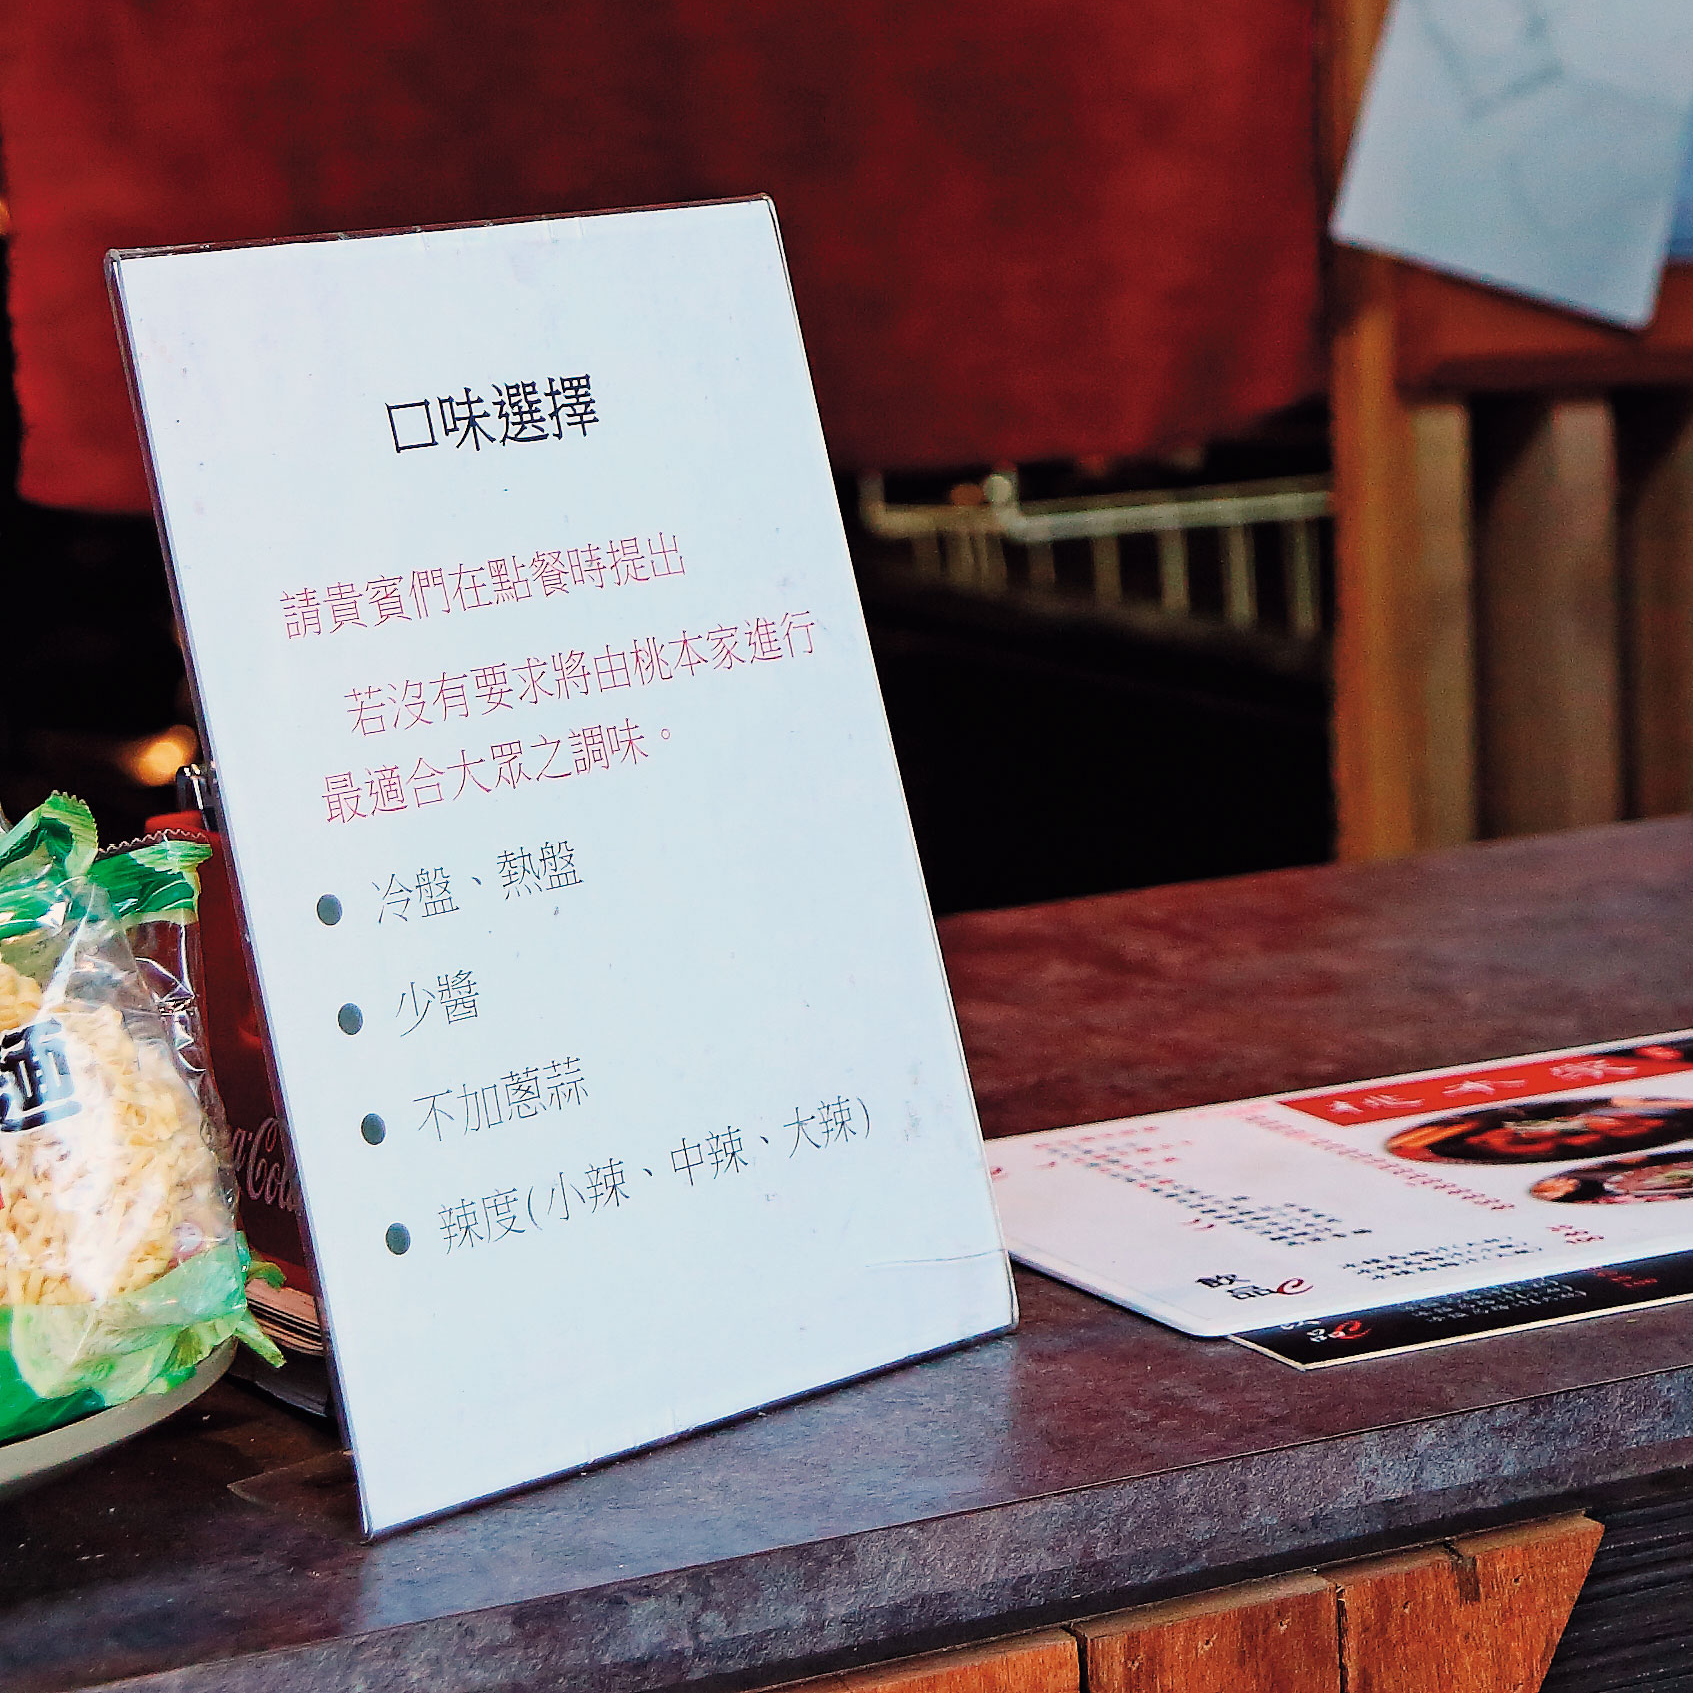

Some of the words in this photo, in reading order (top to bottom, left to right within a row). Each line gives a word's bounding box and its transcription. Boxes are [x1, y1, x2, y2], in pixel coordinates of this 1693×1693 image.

[384, 373, 600, 454] 口味選擇
[279, 531, 687, 640] 請貴賓們在點餐時提出
[343, 609, 817, 737] 若沒有要求將由桃本家進行
[395, 968, 480, 1038] 少醬
